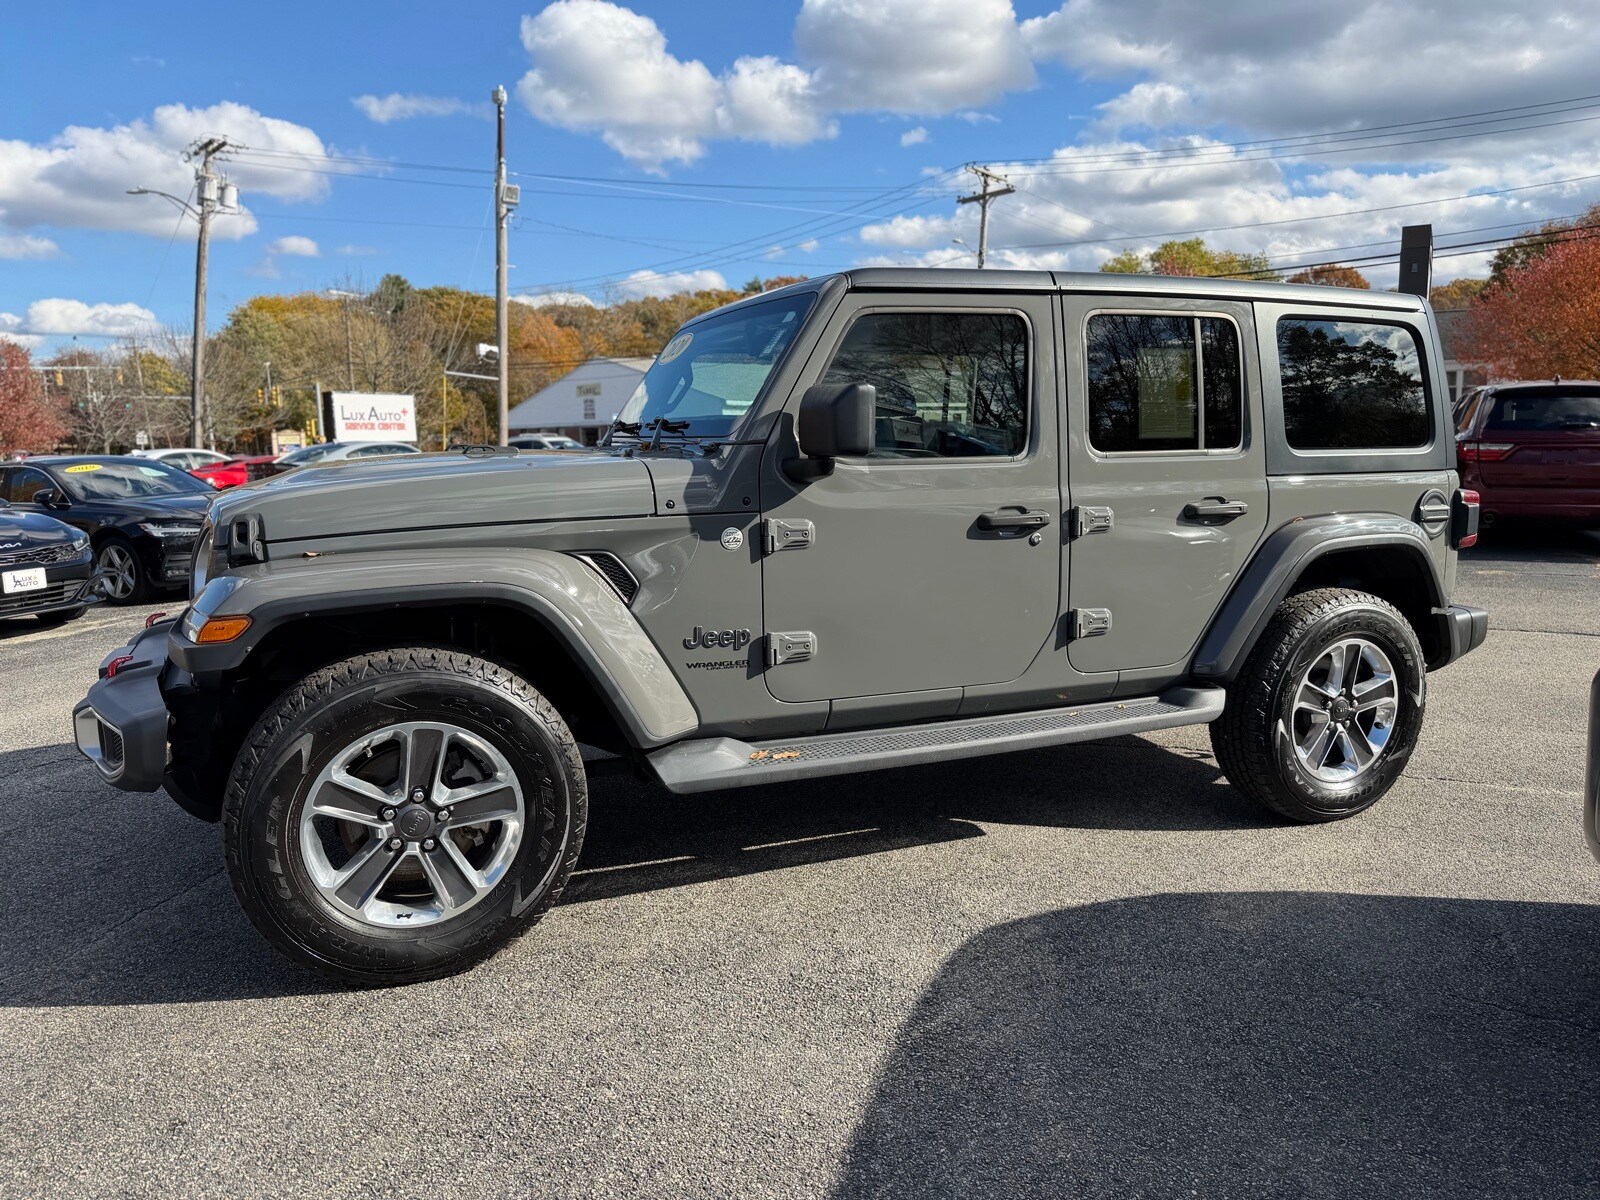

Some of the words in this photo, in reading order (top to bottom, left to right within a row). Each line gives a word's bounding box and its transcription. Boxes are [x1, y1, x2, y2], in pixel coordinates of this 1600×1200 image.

[345, 422, 375, 430] SERVICE
[377, 422, 406, 430] CENTER
[682, 625, 751, 651] Jeep
[685, 659, 750, 670] WRANGLER
